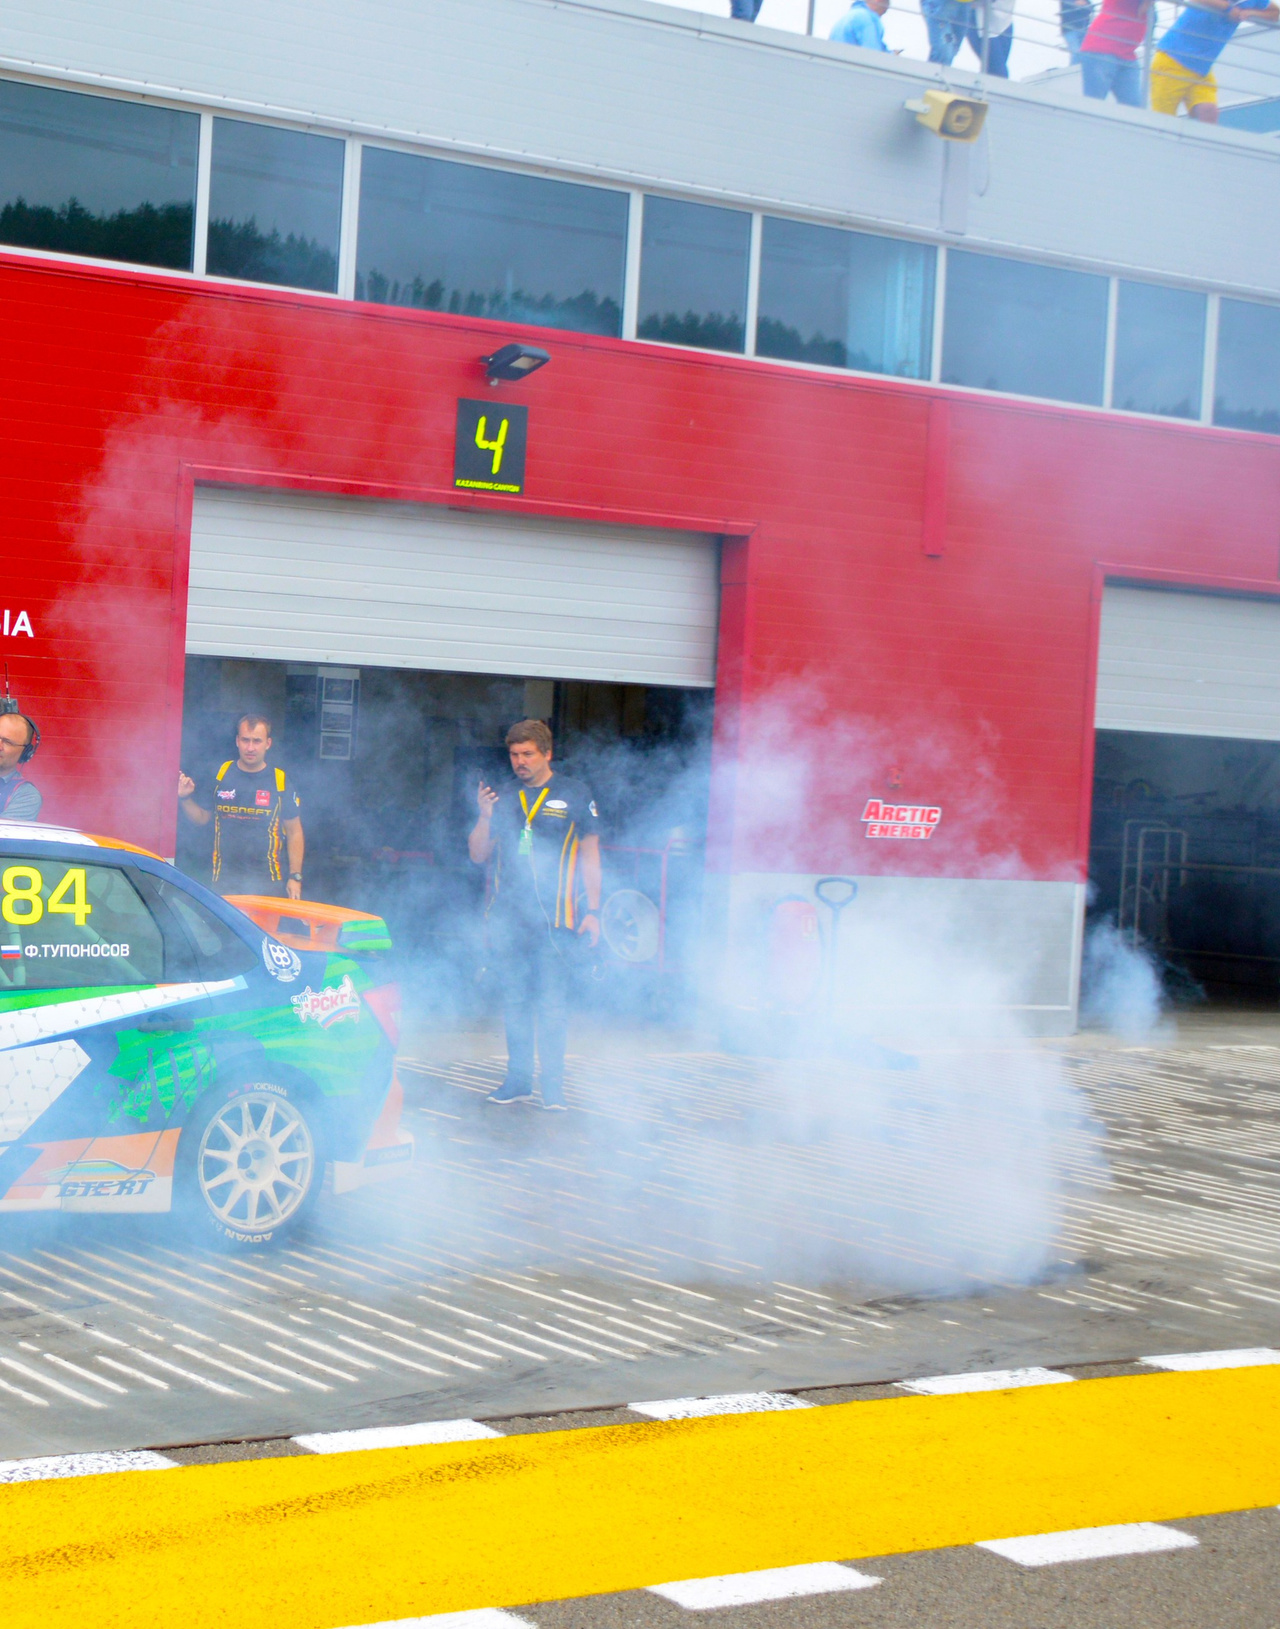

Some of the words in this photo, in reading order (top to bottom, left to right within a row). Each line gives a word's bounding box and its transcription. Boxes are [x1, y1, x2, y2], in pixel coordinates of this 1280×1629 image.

[474, 415, 509, 474] 4
[217, 804, 272, 816] ROSNEFT
[866, 823, 935, 839] ENERGY
[1, 865, 92, 926] 84
[24, 944, 130, 958] Ф.ТУПОНОСОВ
[224, 1227, 273, 1243] ADVAN
